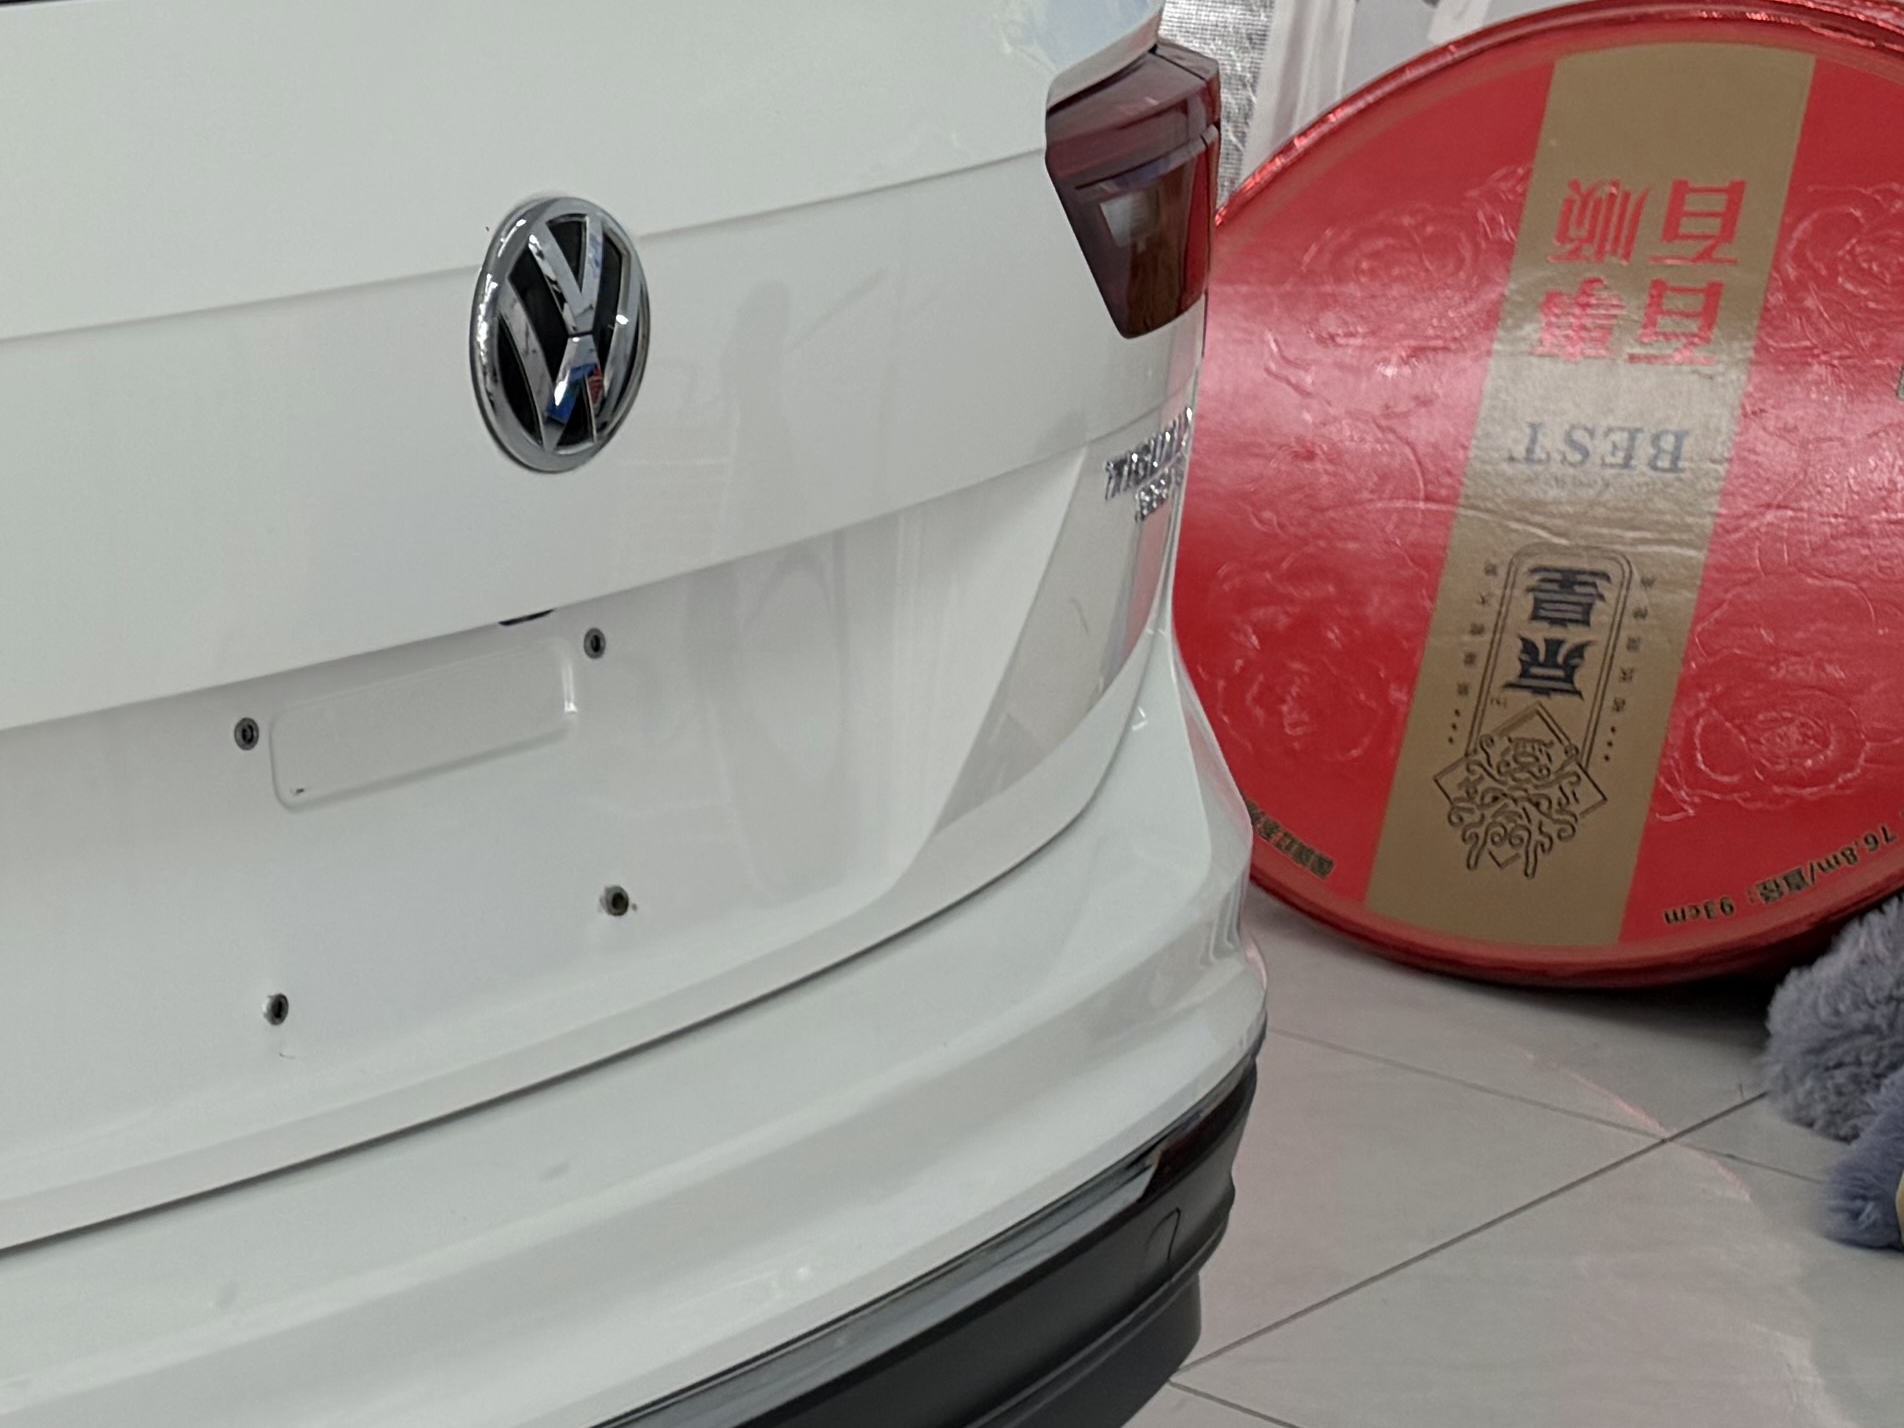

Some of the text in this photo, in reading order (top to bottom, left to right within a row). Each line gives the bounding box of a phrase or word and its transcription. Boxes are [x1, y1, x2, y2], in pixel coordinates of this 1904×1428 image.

[1555, 178, 1746, 265] 百顺
[1534, 278, 1725, 365] 百事
[1506, 422, 1690, 474] BEST
